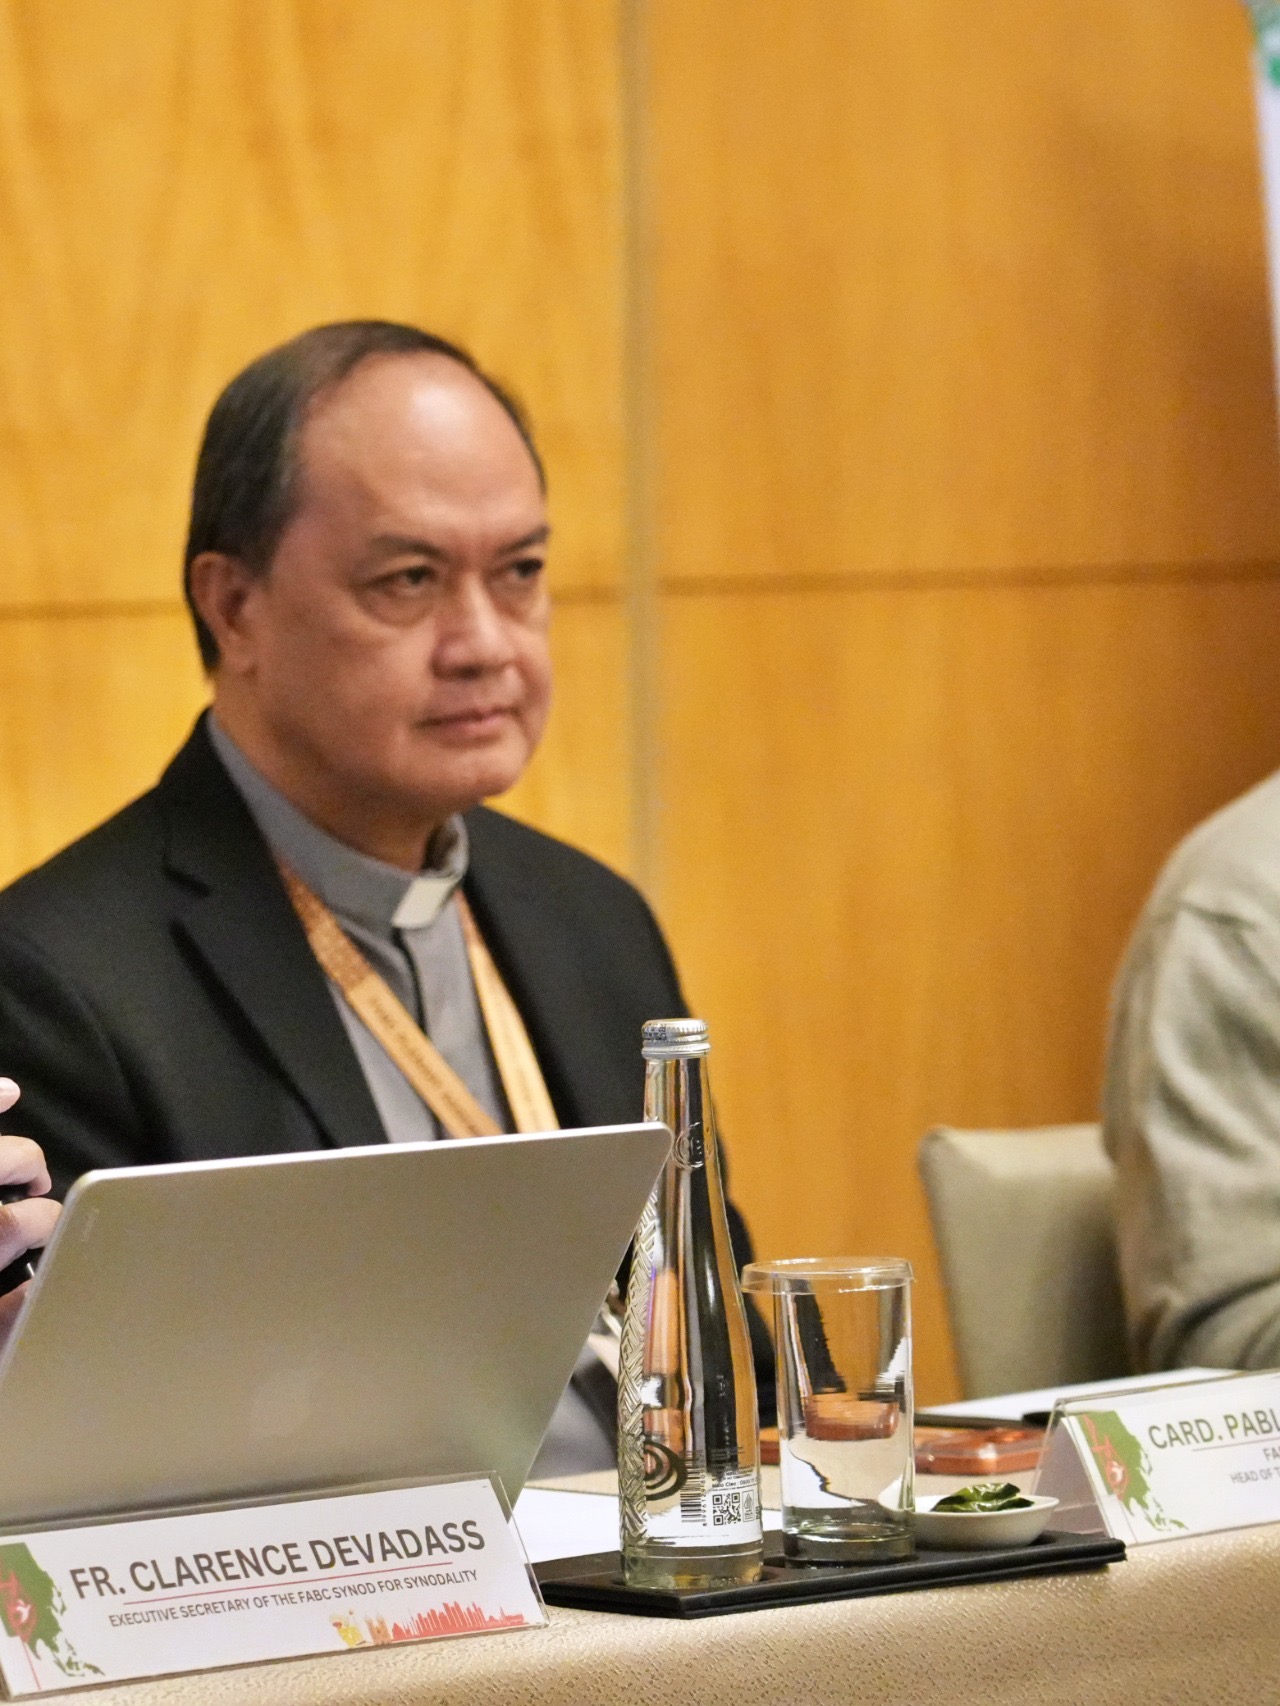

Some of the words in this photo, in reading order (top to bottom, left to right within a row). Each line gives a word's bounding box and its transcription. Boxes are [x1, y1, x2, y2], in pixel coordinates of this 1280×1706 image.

[1148, 1418, 1223, 1449] CARD.
[1263, 1446, 1280, 1461] FA
[1229, 1469, 1259, 1484] HEAD
[1259, 1467, 1273, 1481] OF
[69, 1565, 126, 1599] FR.
[129, 1542, 308, 1592] CLARENCE
[308, 1520, 485, 1570] DEVADASS
[108, 1607, 179, 1628] EXECUTIVE
[180, 1597, 252, 1619] SECRETARY
[253, 1595, 270, 1609] OF
[271, 1591, 297, 1606] THE
[297, 1588, 332, 1604] FABC
[332, 1582, 376, 1599] SYNOD
[377, 1578, 403, 1593] FOR
[403, 1569, 478, 1589] SYNODALITY
